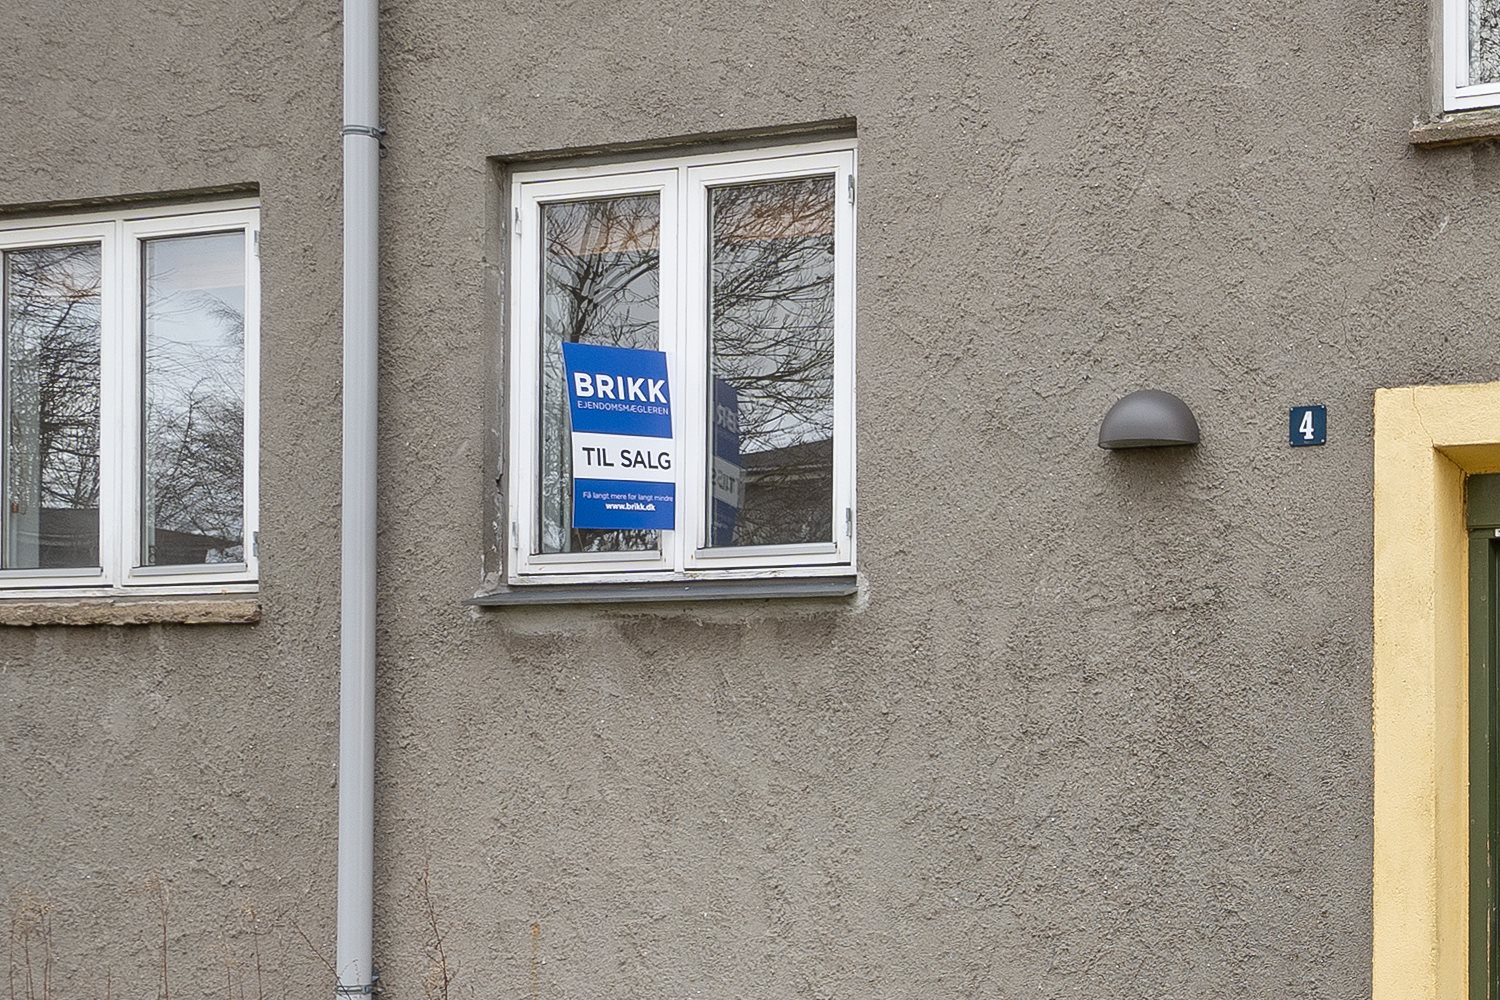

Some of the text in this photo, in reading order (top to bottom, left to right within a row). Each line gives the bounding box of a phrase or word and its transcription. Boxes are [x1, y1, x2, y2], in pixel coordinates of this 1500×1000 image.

[574, 372, 668, 403] BRIKK
[577, 401, 669, 415] EJENDOMSMÆGLEREN
[1299, 411, 1314, 439] 4
[582, 447, 671, 470] TIL SALG
[593, 491, 609, 500] langt
[638, 494, 653, 502] langt
[605, 503, 656, 511] www.brikk.dk
